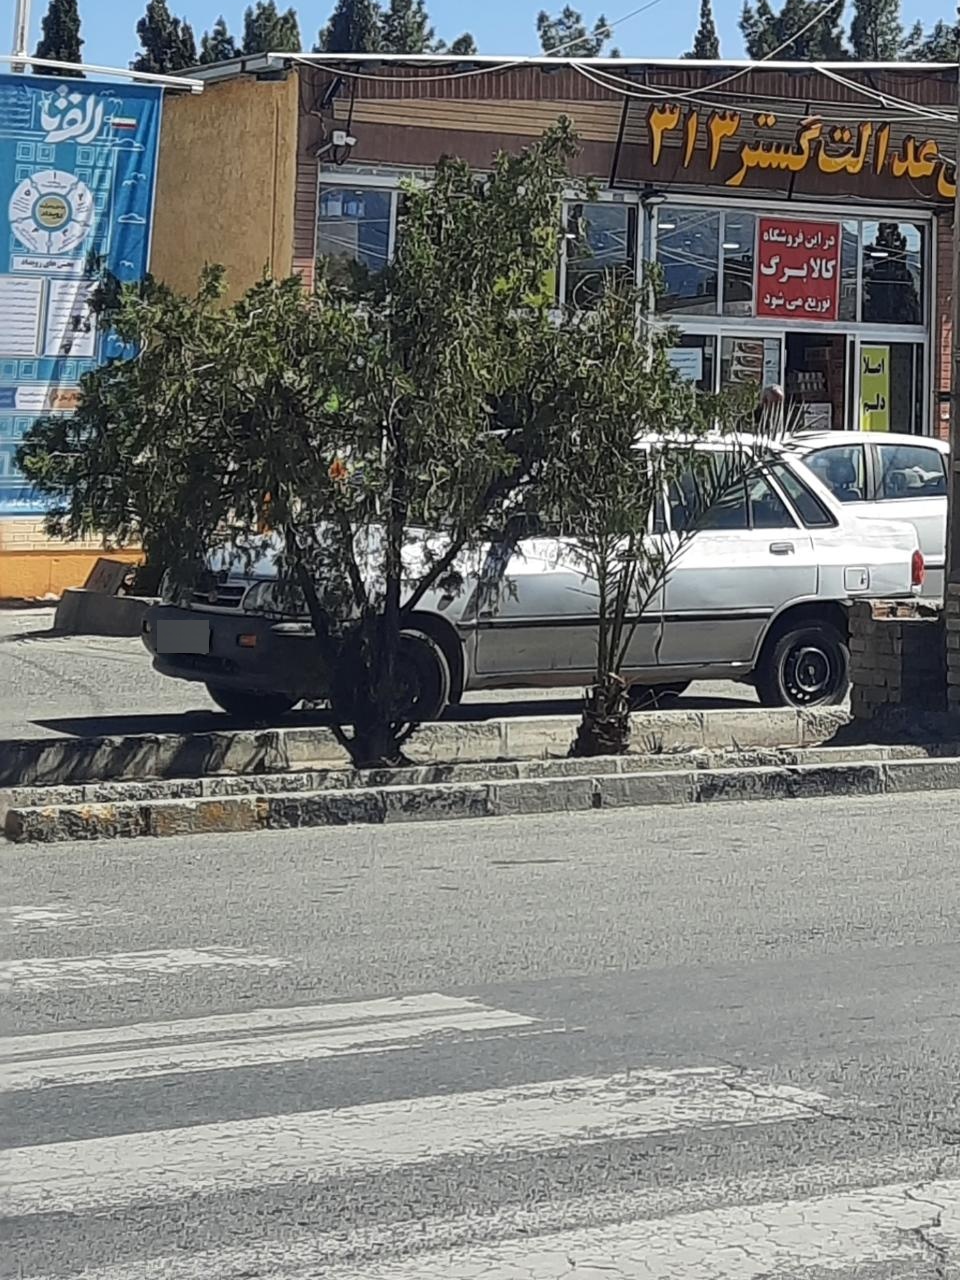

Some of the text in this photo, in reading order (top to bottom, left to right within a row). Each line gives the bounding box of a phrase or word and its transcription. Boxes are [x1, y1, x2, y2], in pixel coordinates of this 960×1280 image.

[649, 103, 741, 170] ۳۱۳
[725, 113, 824, 186] گستر
[818, 121, 939, 178] عدالت
[763, 227, 836, 250] در این فروشگاه
[763, 291, 831, 312] توزیع می شود
